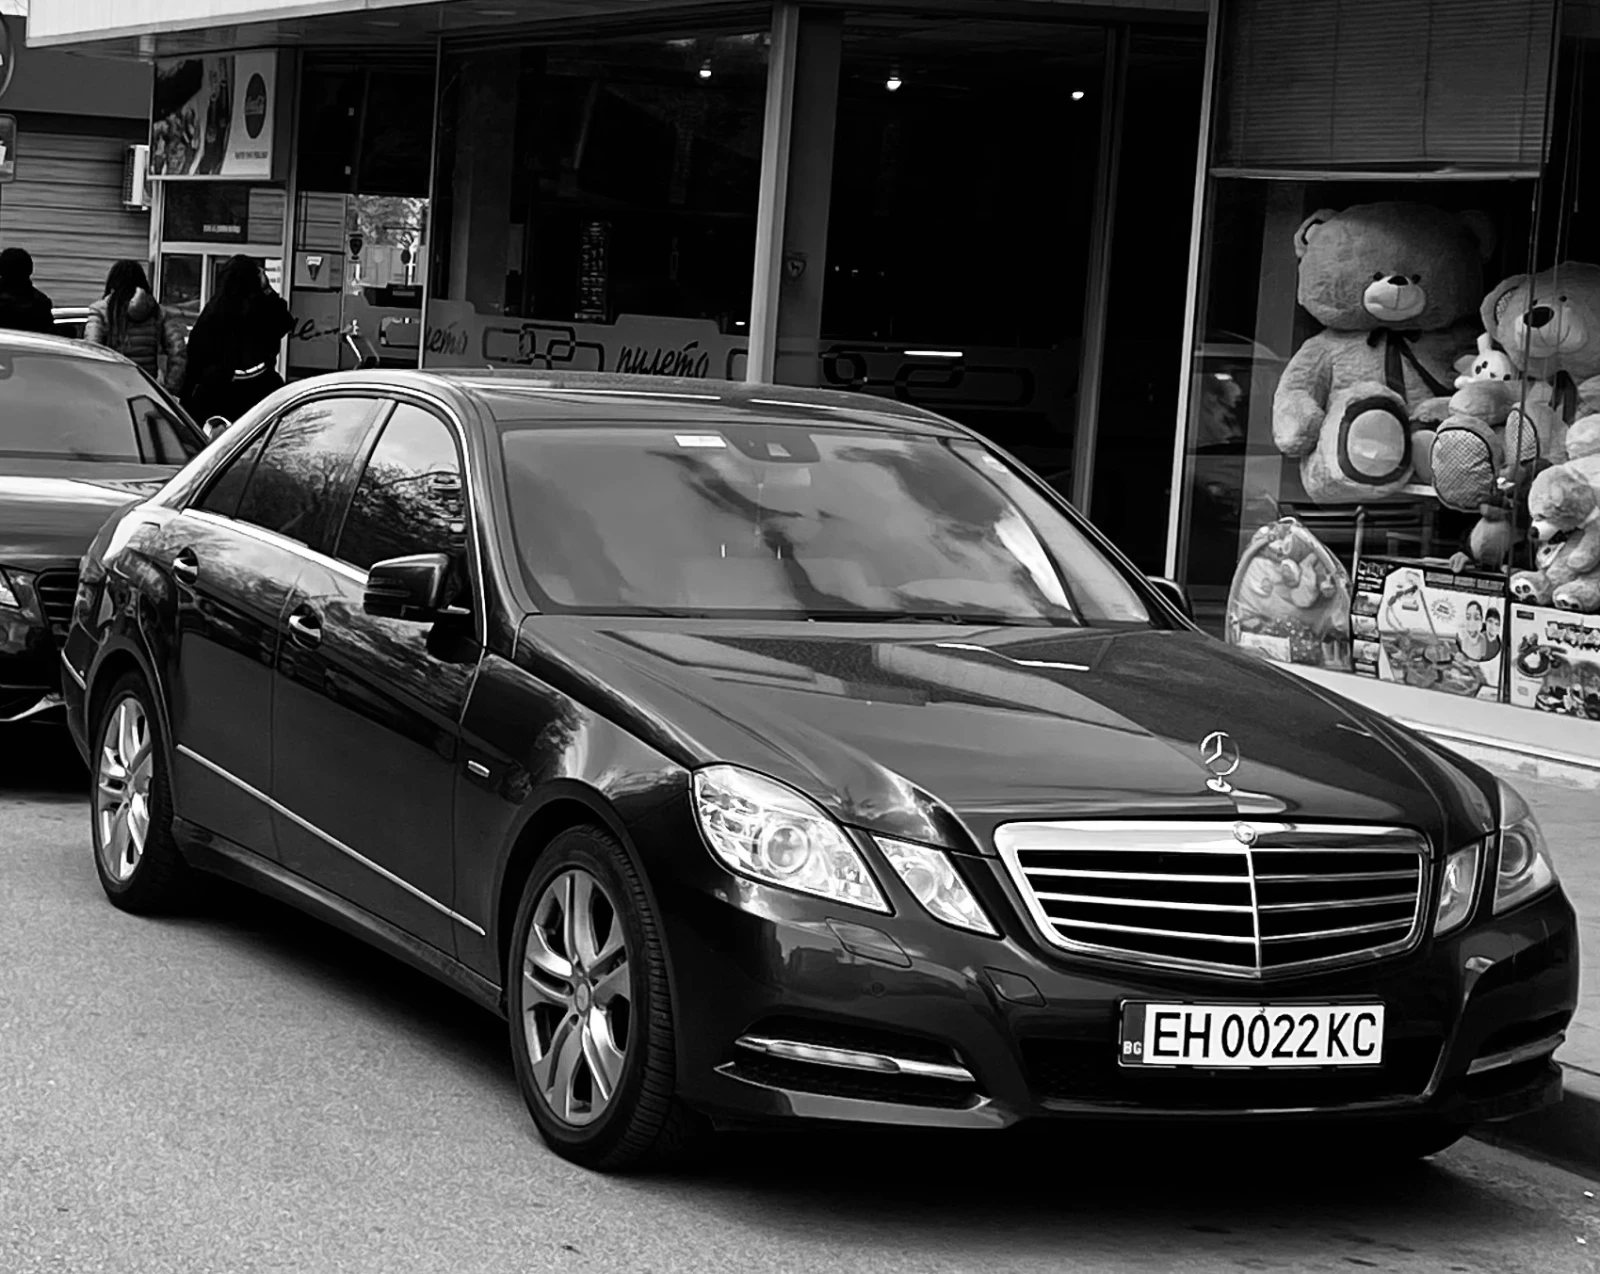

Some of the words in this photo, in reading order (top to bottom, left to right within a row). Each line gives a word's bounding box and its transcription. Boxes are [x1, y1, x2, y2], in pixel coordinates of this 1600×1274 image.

[1123, 1041, 1142, 1055] BG
[1152, 1011, 1213, 1058] EH
[1220, 1013, 1320, 1059] 0022
[1326, 1011, 1377, 1058] KC
